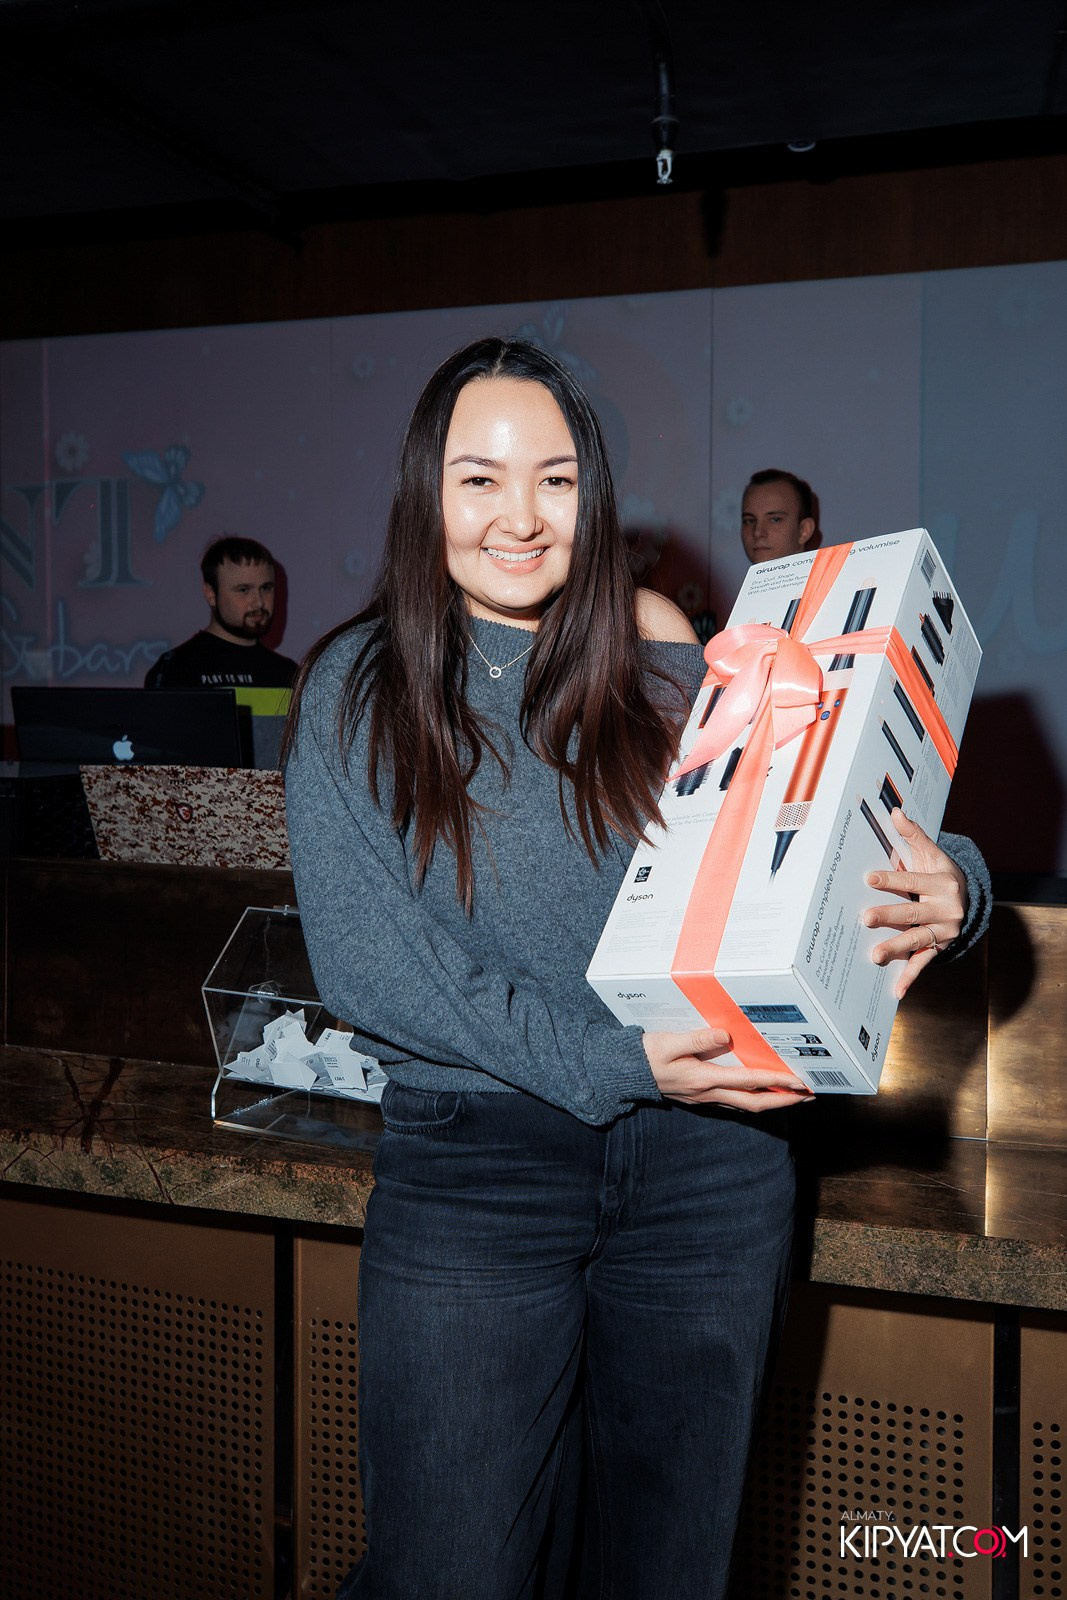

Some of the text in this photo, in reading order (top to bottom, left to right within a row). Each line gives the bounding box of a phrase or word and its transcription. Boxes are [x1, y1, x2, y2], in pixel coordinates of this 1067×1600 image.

[756, 562, 790, 575] airwrap
[858, 540, 900, 553] volumise
[201, 674, 223, 684] PLAY
[225, 674, 236, 683] TO
[805, 809, 853, 963] airwrap complete long volumise
[626, 893, 654, 903] dyson
[617, 991, 646, 999] dyson
[871, 1032, 881, 1062] dyson
